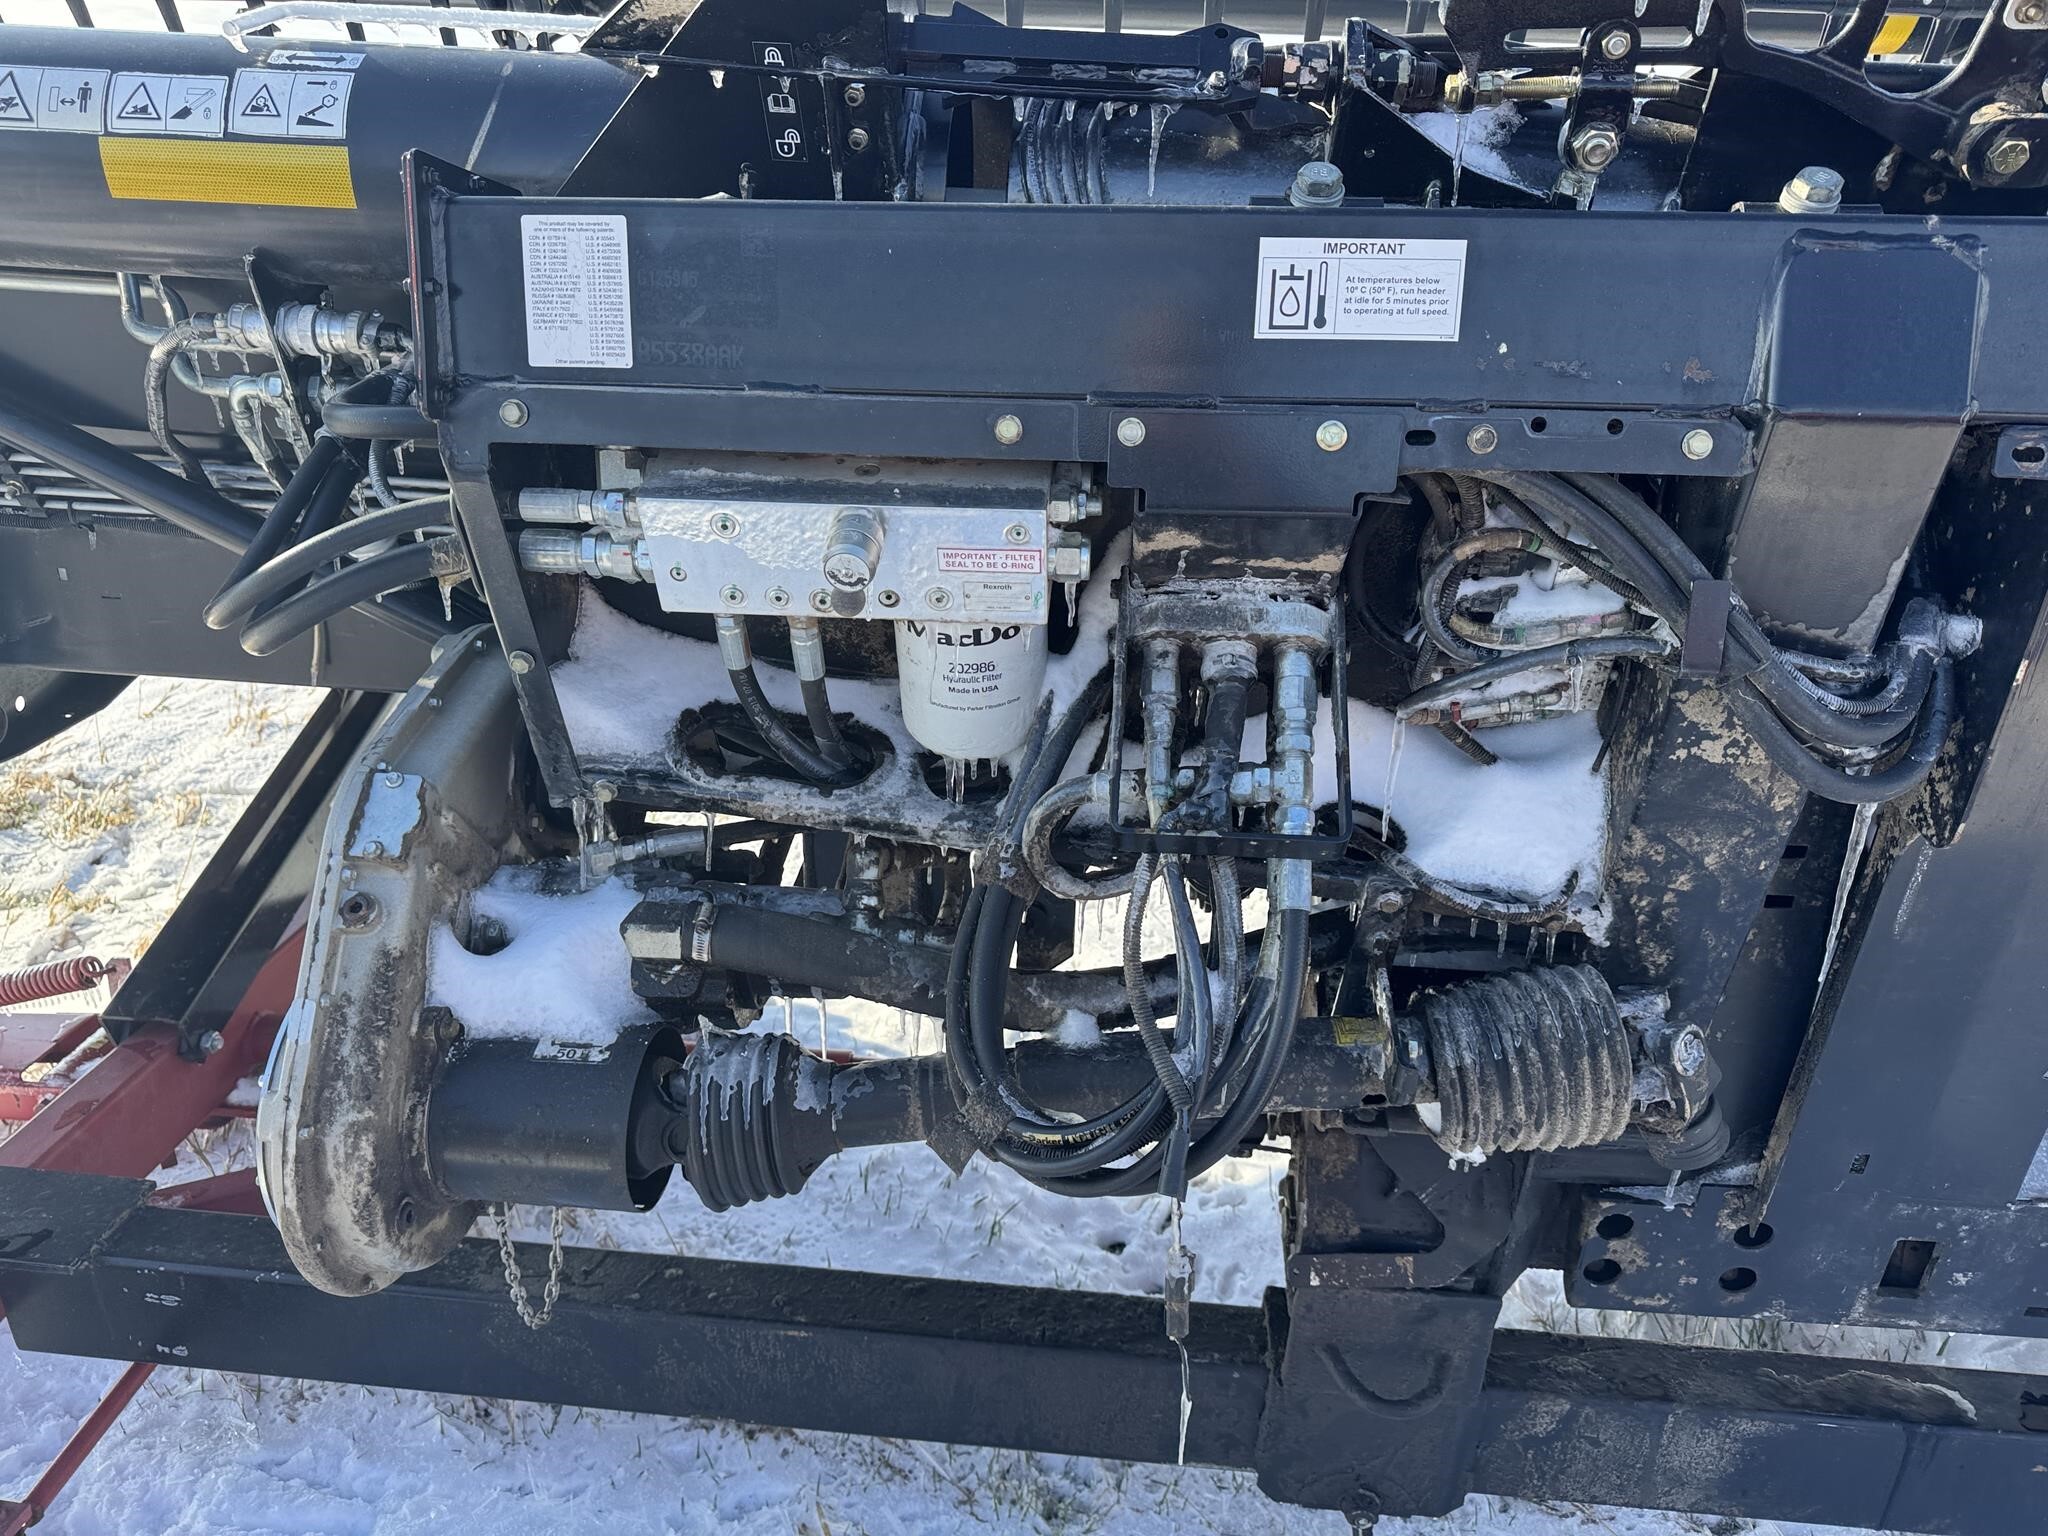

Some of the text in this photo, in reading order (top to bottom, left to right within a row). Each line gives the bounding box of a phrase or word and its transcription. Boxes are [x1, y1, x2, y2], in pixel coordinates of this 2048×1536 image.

[1323, 243, 1405, 255] IMPORTANT
[1358, 276, 1412, 285] temperatures
[1415, 277, 1440, 285] below
[1361, 286, 1367, 294] C
[1417, 287, 1446, 295] header
[1355, 296, 1369, 304] idle
[1393, 297, 1426, 305] minutes
[1429, 298, 1449, 307] prior
[1355, 307, 1393, 317] operating
[1406, 307, 1419, 315] full
[1422, 308, 1449, 316] speed.
[1001, 562, 1034, 570] O-RING
[943, 672, 1002, 684] Hydraulic Filter
[982, 685, 999, 693] USA
